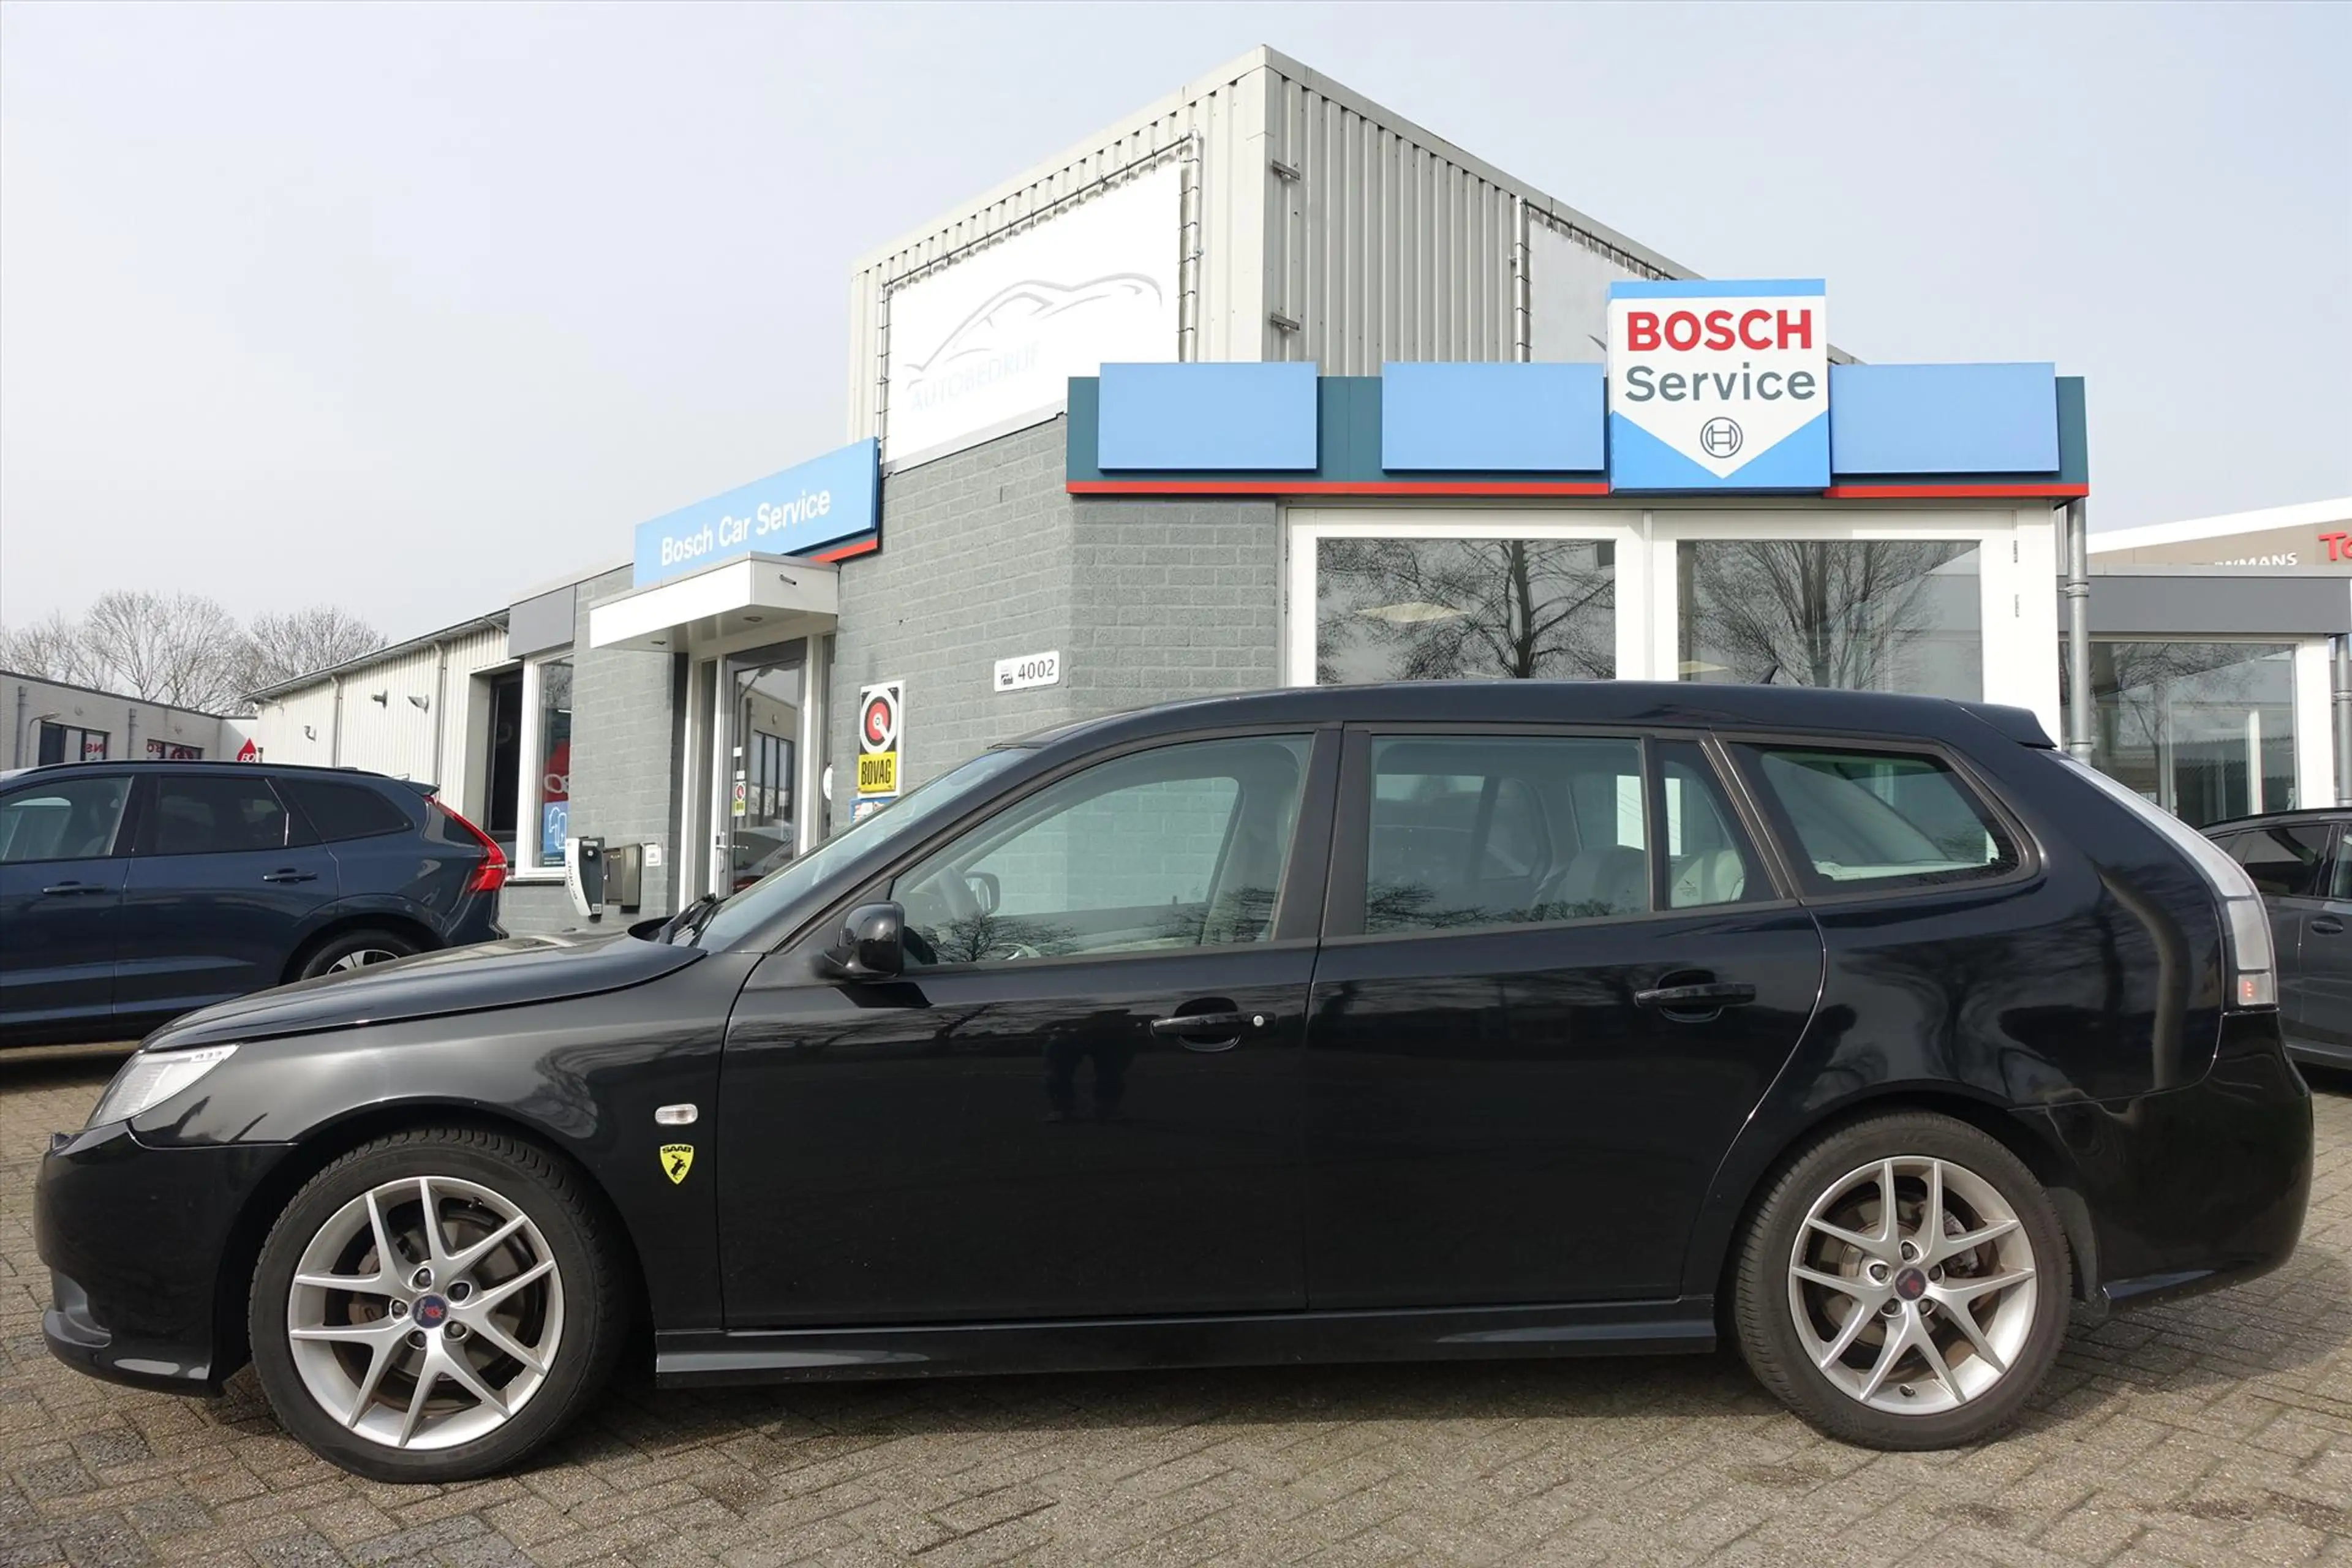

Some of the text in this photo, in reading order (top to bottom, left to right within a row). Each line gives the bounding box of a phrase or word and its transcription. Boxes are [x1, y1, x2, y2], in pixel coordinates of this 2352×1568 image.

[1627, 309, 1812, 351] BOSCH
[1625, 362, 1815, 402] Service
[662, 489, 831, 566] Bosch Car Service
[1018, 658, 1054, 680] 4002
[861, 758, 892, 785] BOVAG
[662, 1145, 692, 1154] SAAB
